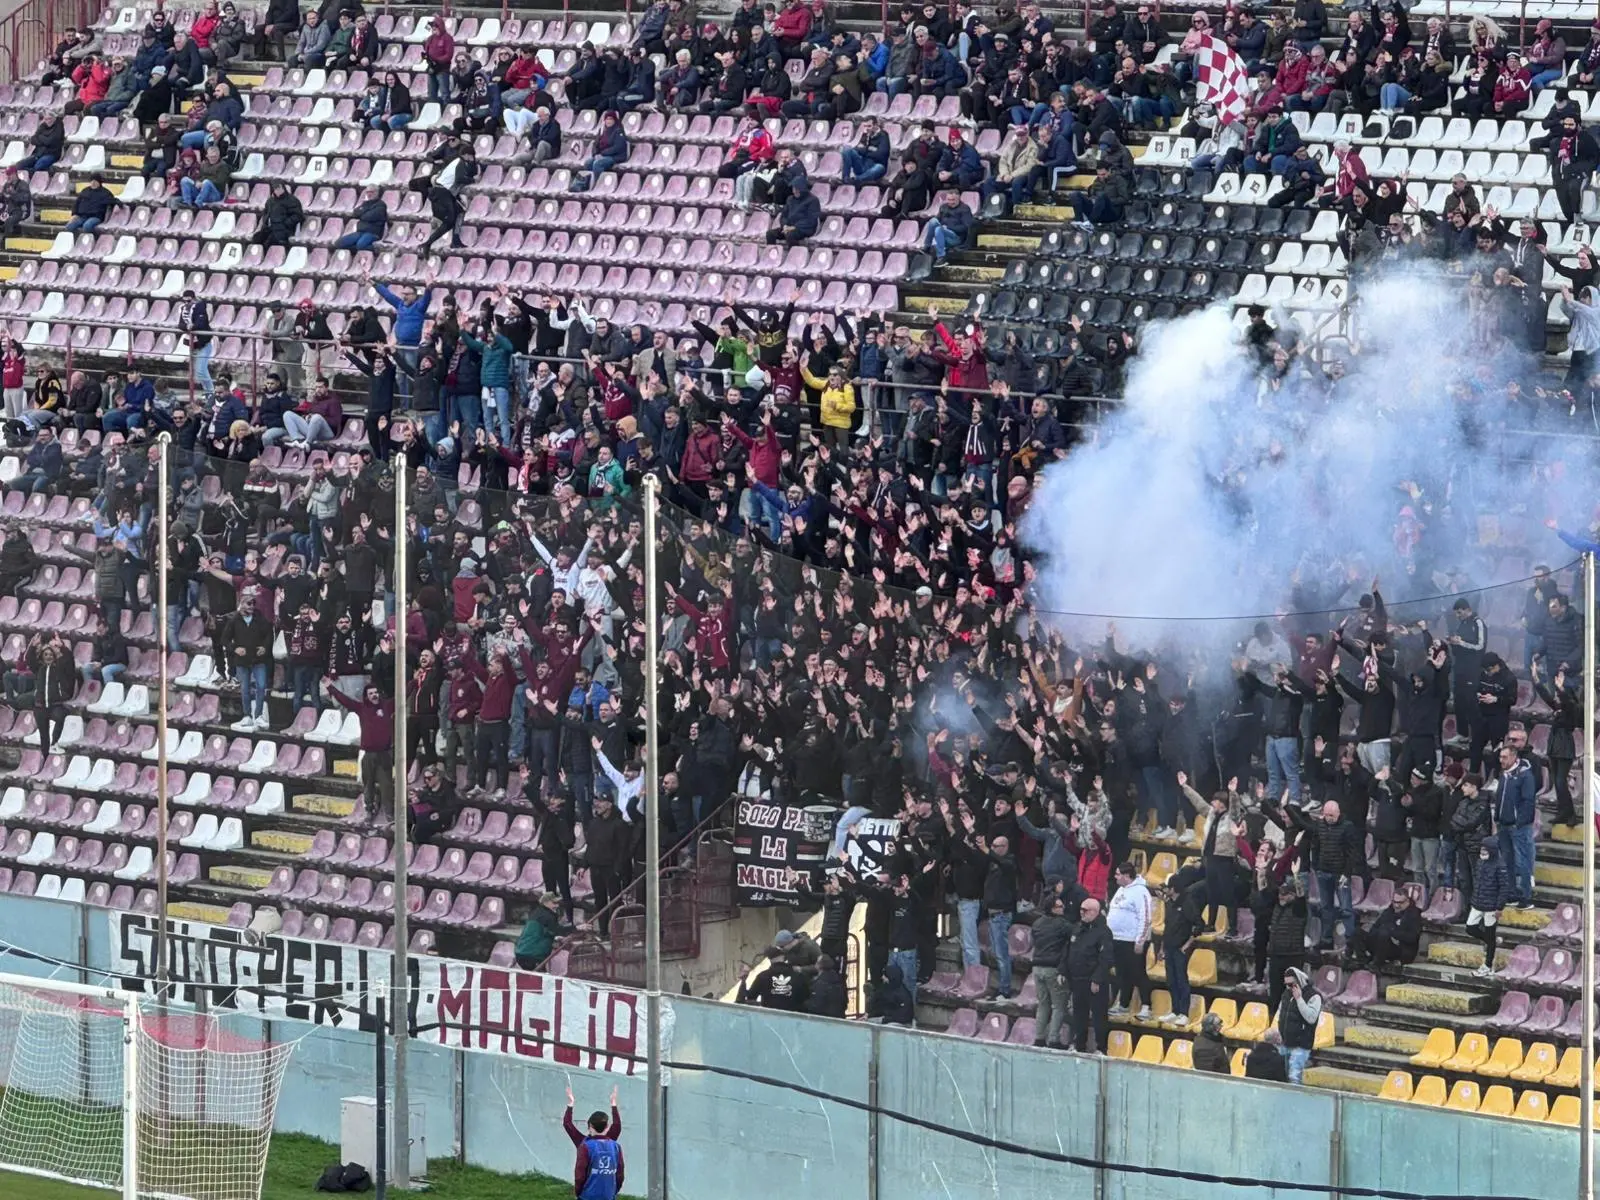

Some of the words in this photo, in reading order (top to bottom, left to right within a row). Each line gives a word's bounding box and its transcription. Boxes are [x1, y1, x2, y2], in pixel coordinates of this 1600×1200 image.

[738, 801, 782, 828] SOLO
[761, 835, 787, 861] LA
[258, 934, 343, 1027] PER
[437, 963, 638, 1076] MAGLIA
